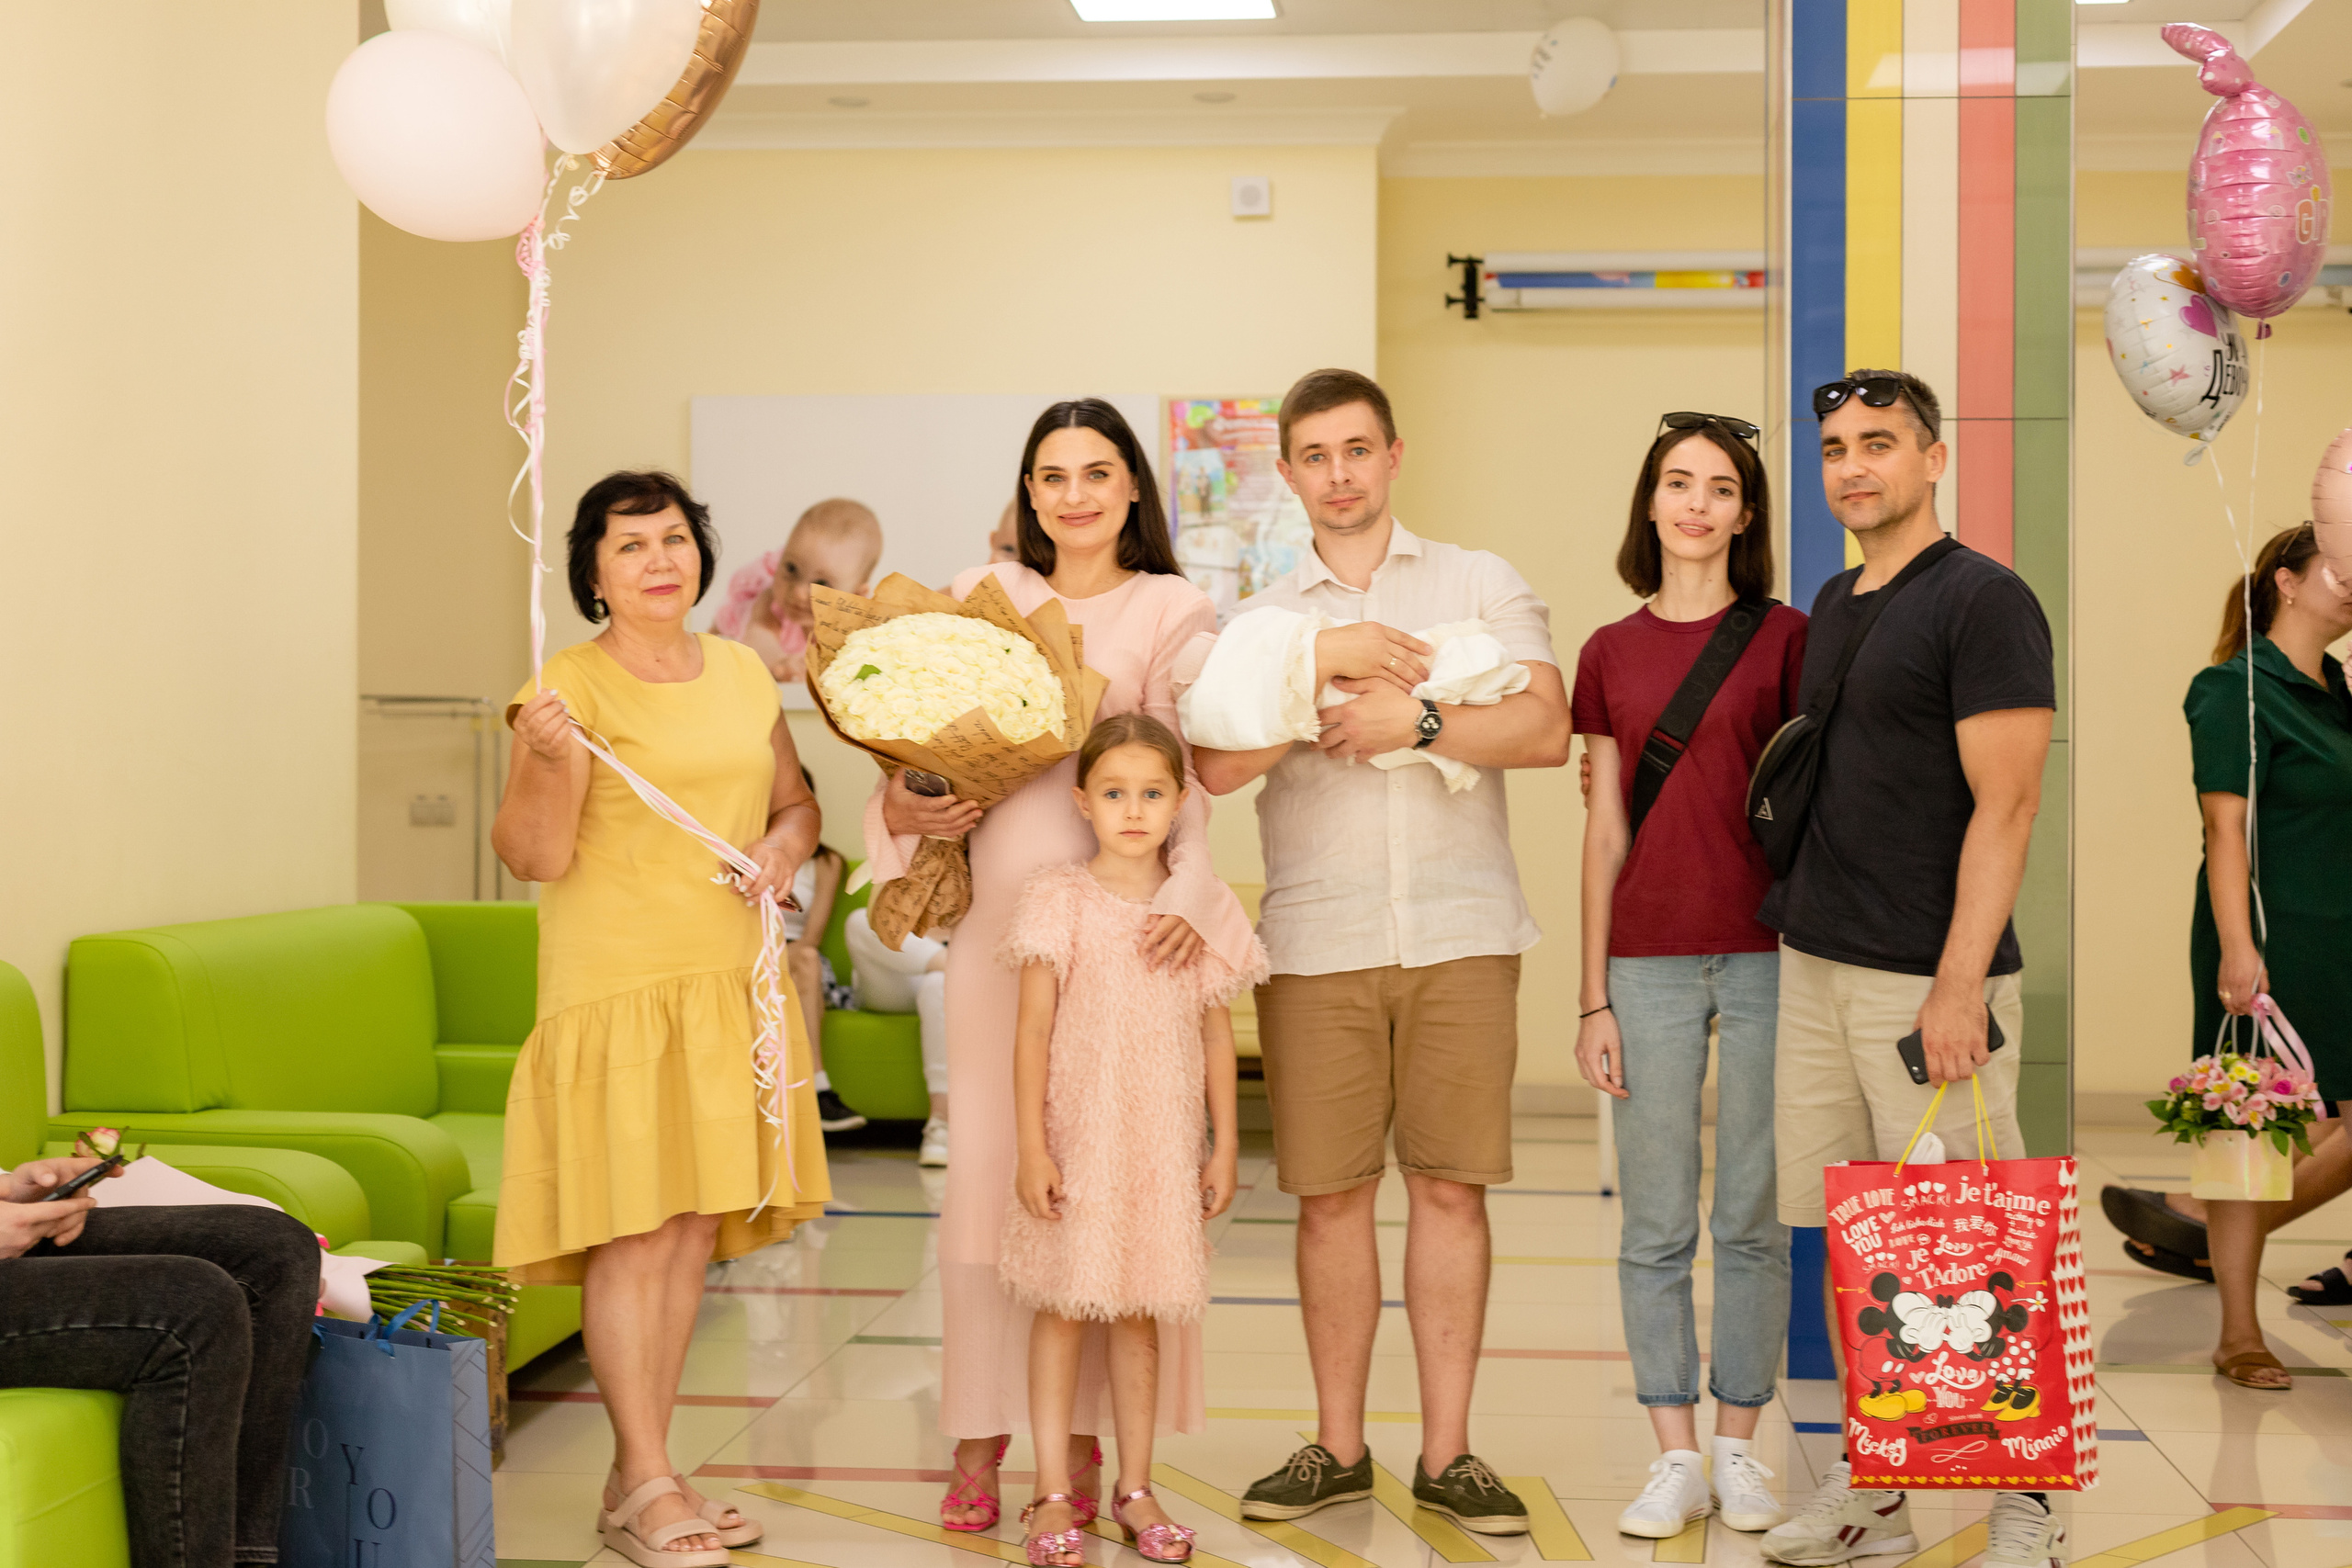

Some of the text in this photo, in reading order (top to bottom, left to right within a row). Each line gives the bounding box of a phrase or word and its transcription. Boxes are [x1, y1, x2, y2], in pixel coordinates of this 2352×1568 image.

[1828, 1189, 1895, 1225] TRUE LOVE
[1900, 1192, 1951, 1212] SMACK!
[1983, 1182, 2052, 1215] t'aime
[1841, 1215, 1882, 1244] LOVE
[1850, 1233, 1883, 1256] YOU
[1932, 1234, 1974, 1257] Love
[1924, 1351, 1986, 1390] Love
[1848, 1417, 1907, 1467] Mickey
[1920, 1422, 1992, 1445] FOREVER
[2001, 1426, 2069, 1461] Minnie
